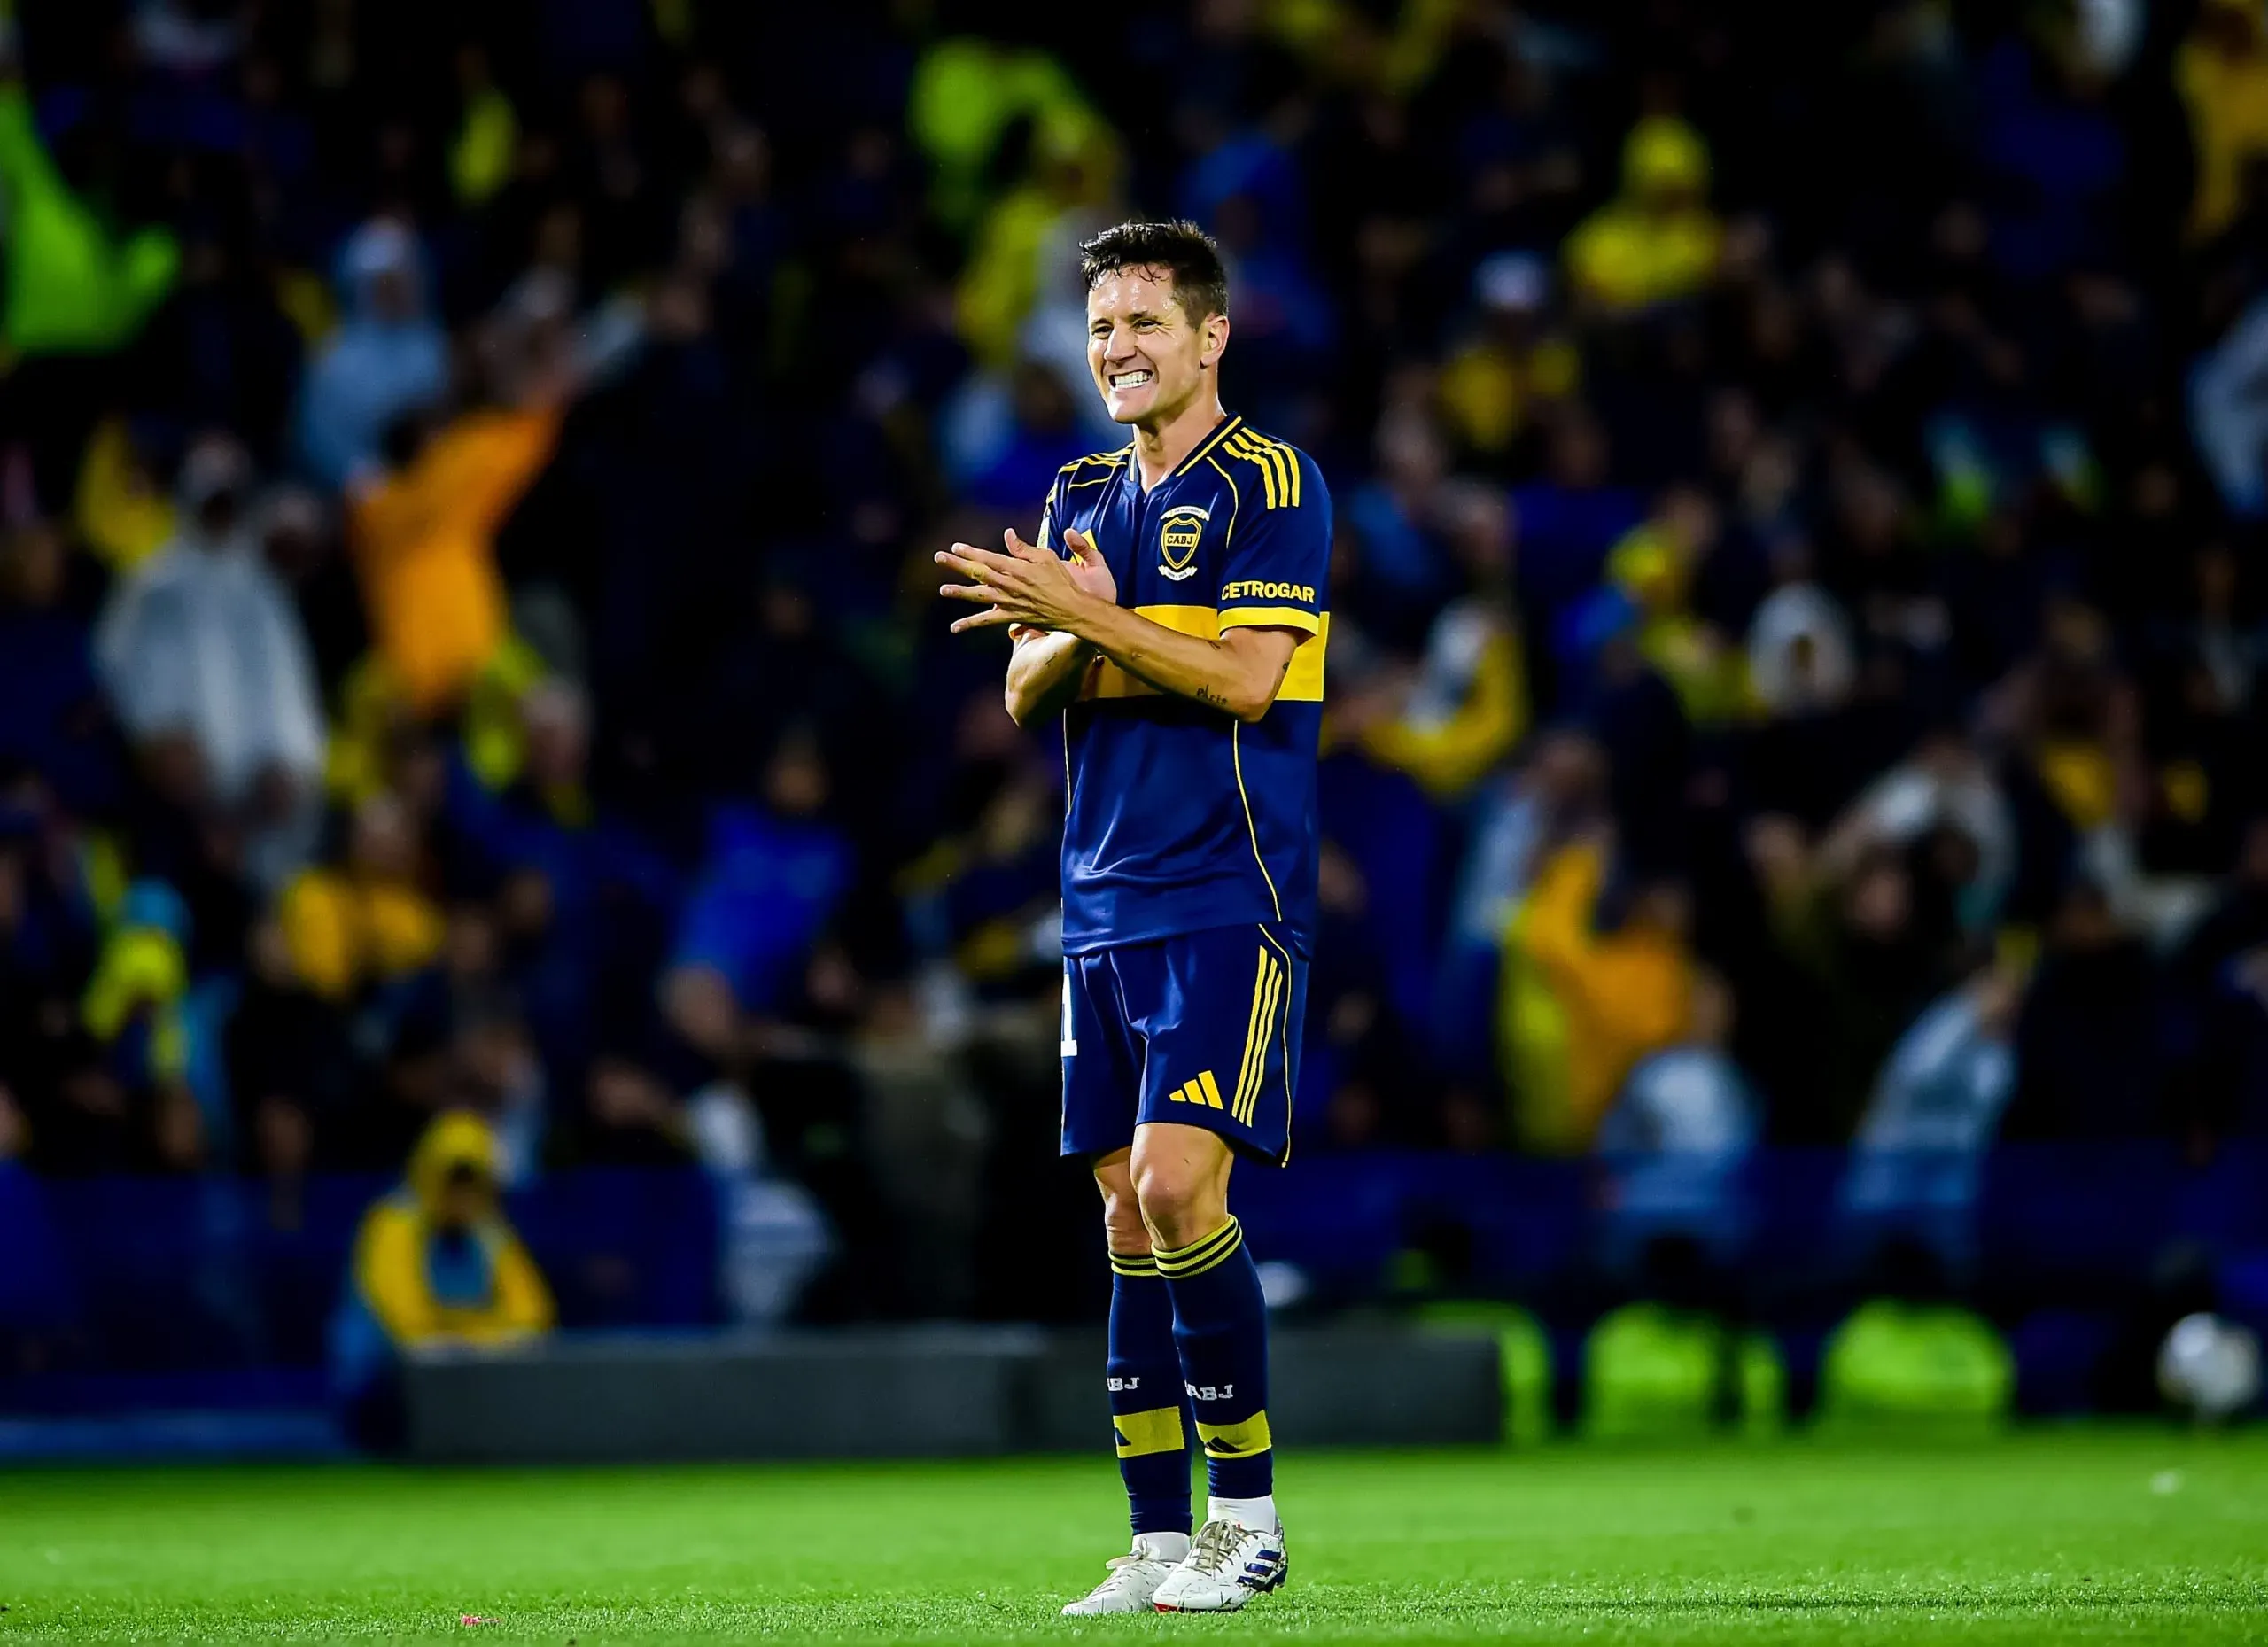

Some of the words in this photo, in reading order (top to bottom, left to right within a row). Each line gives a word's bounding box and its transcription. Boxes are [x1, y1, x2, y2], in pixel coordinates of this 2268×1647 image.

[1167, 535, 1193, 545] CABJ
[1221, 580, 1316, 603] CETROGAR
[1184, 1379, 1234, 1401] ABJ
